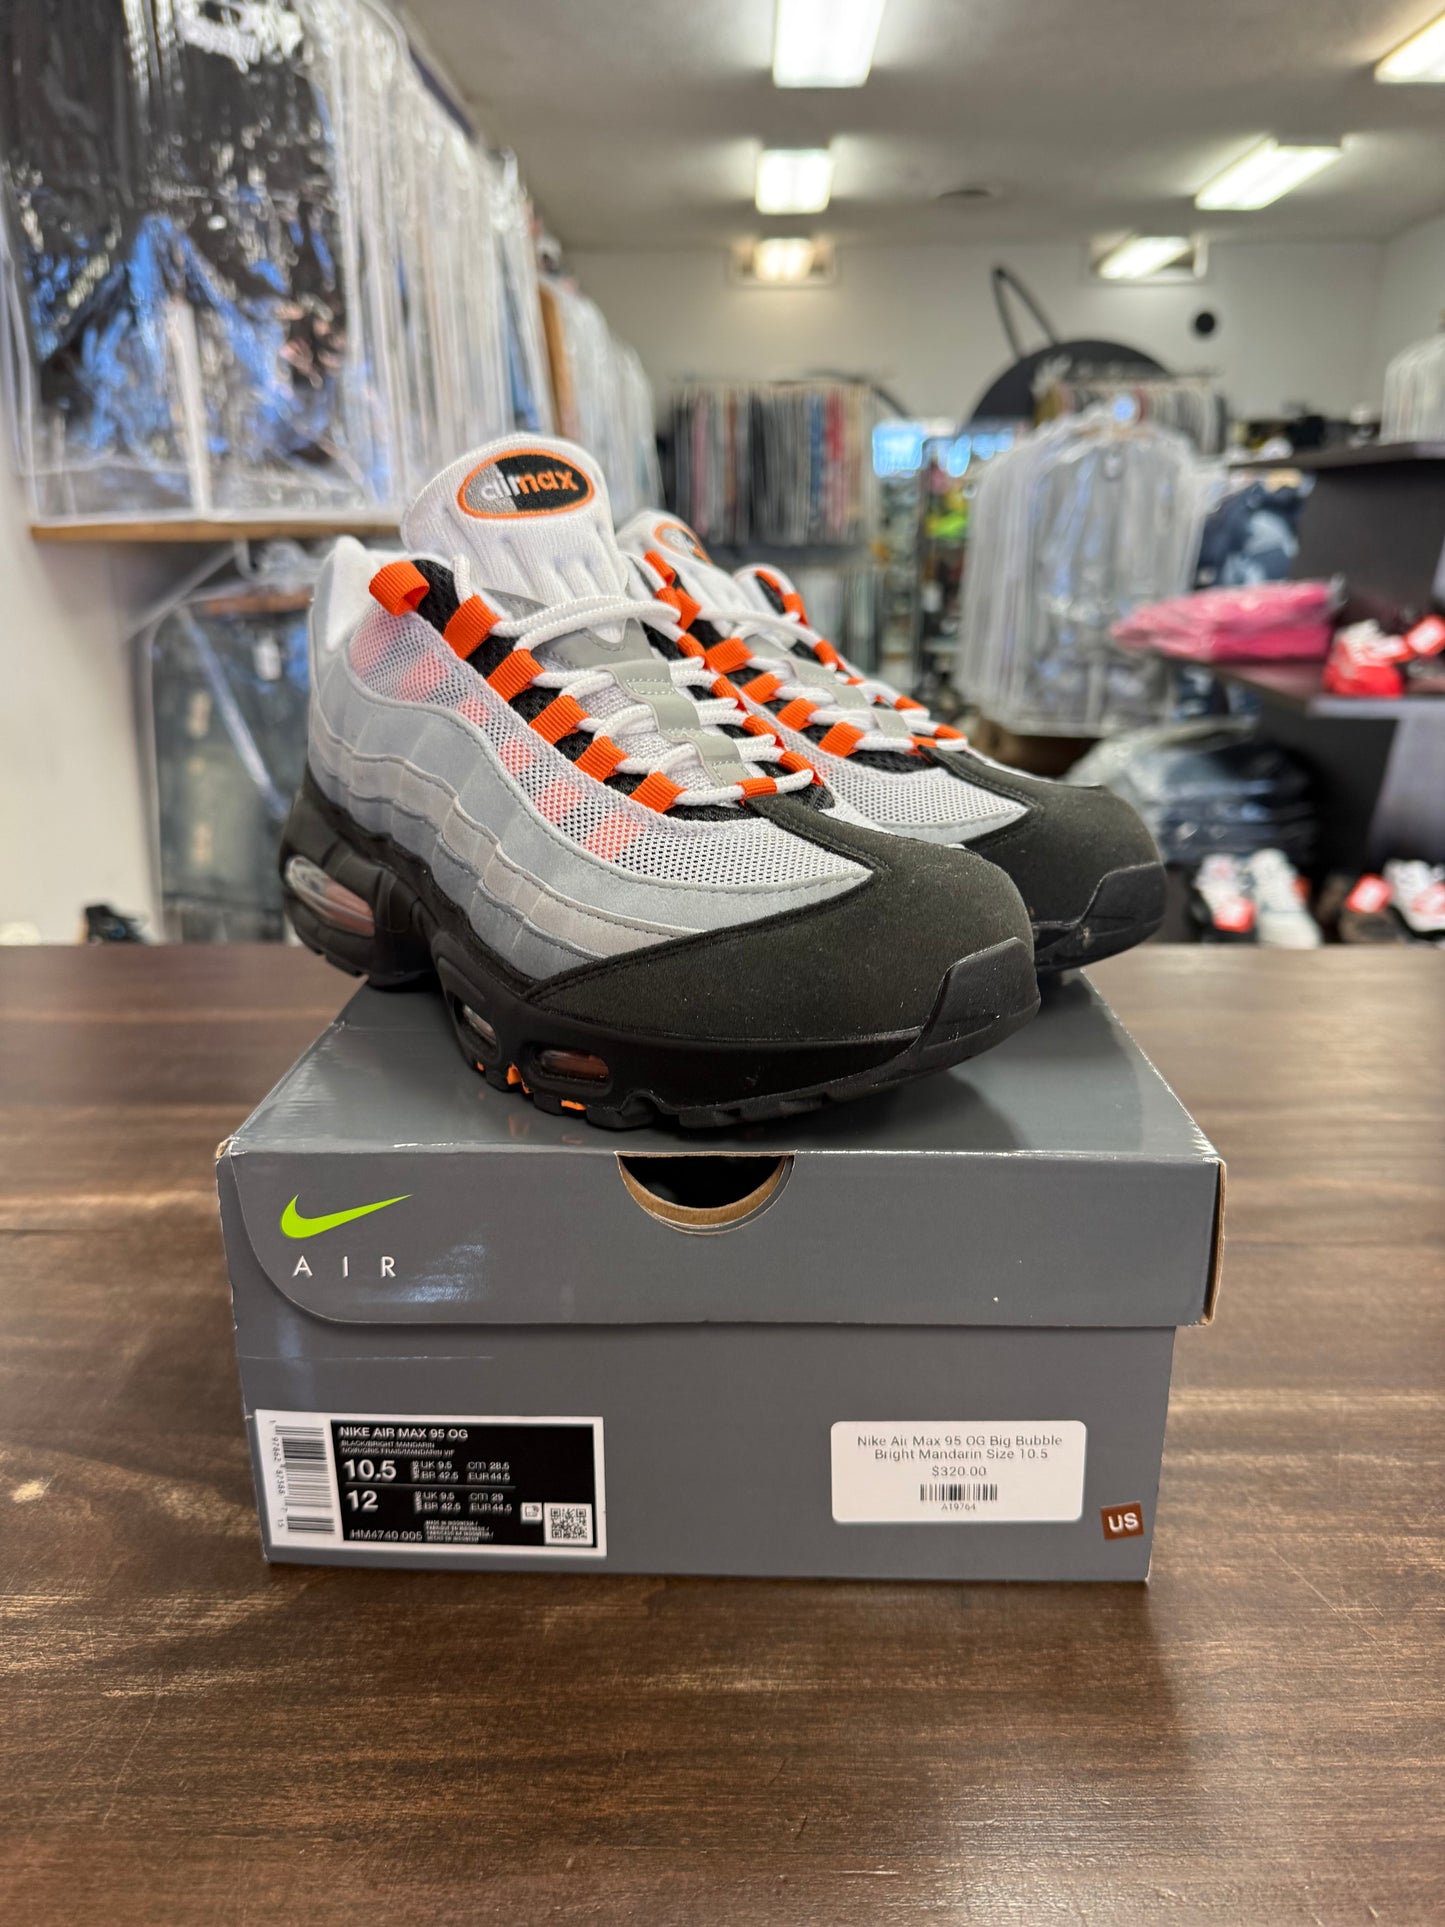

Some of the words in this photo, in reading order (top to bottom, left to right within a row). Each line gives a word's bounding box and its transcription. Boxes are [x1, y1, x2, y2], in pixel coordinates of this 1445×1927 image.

[292, 1255, 397, 1278] AIR
[339, 1426, 370, 1437] NIKE
[373, 1427, 396, 1438] AIR
[398, 1427, 427, 1438] MAX
[430, 1428, 445, 1439] 95
[448, 1428, 468, 1439] OG
[857, 1435, 886, 1446] Nike
[891, 1435, 907, 1446] Air
[913, 1435, 941, 1446] Max
[945, 1435, 961, 1446] 95
[966, 1435, 985, 1446] OG
[990, 1435, 1011, 1448] Big
[1015, 1435, 1063, 1446] Bubble
[875, 1448, 914, 1461] Bright
[919, 1448, 982, 1459] Mandarin
[986, 1448, 1014, 1459] Size
[1020, 1448, 1048, 1459] 10.5
[343, 1459, 397, 1481] 10.5
[420, 1460, 435, 1469] UK
[437, 1461, 452, 1470] 9.5
[489, 1461, 510, 1471] 28.5
[931, 1465, 987, 1477] $320.00
[421, 1471, 436, 1479] BR
[438, 1471, 459, 1480] 42.5
[468, 1472, 489, 1480] EUR
[490, 1472, 510, 1481] 44.5
[347, 1490, 379, 1512] 12
[423, 1491, 438, 1500] UK
[440, 1492, 455, 1501] 9.5
[491, 1493, 504, 1502] 29
[424, 1502, 438, 1510] BR
[441, 1502, 461, 1511] 42.5
[471, 1503, 491, 1512] EUR
[492, 1503, 512, 1512] 44.5
[1108, 1512, 1139, 1533] US
[351, 1529, 398, 1540] HM4740
[400, 1531, 422, 1541] 005
